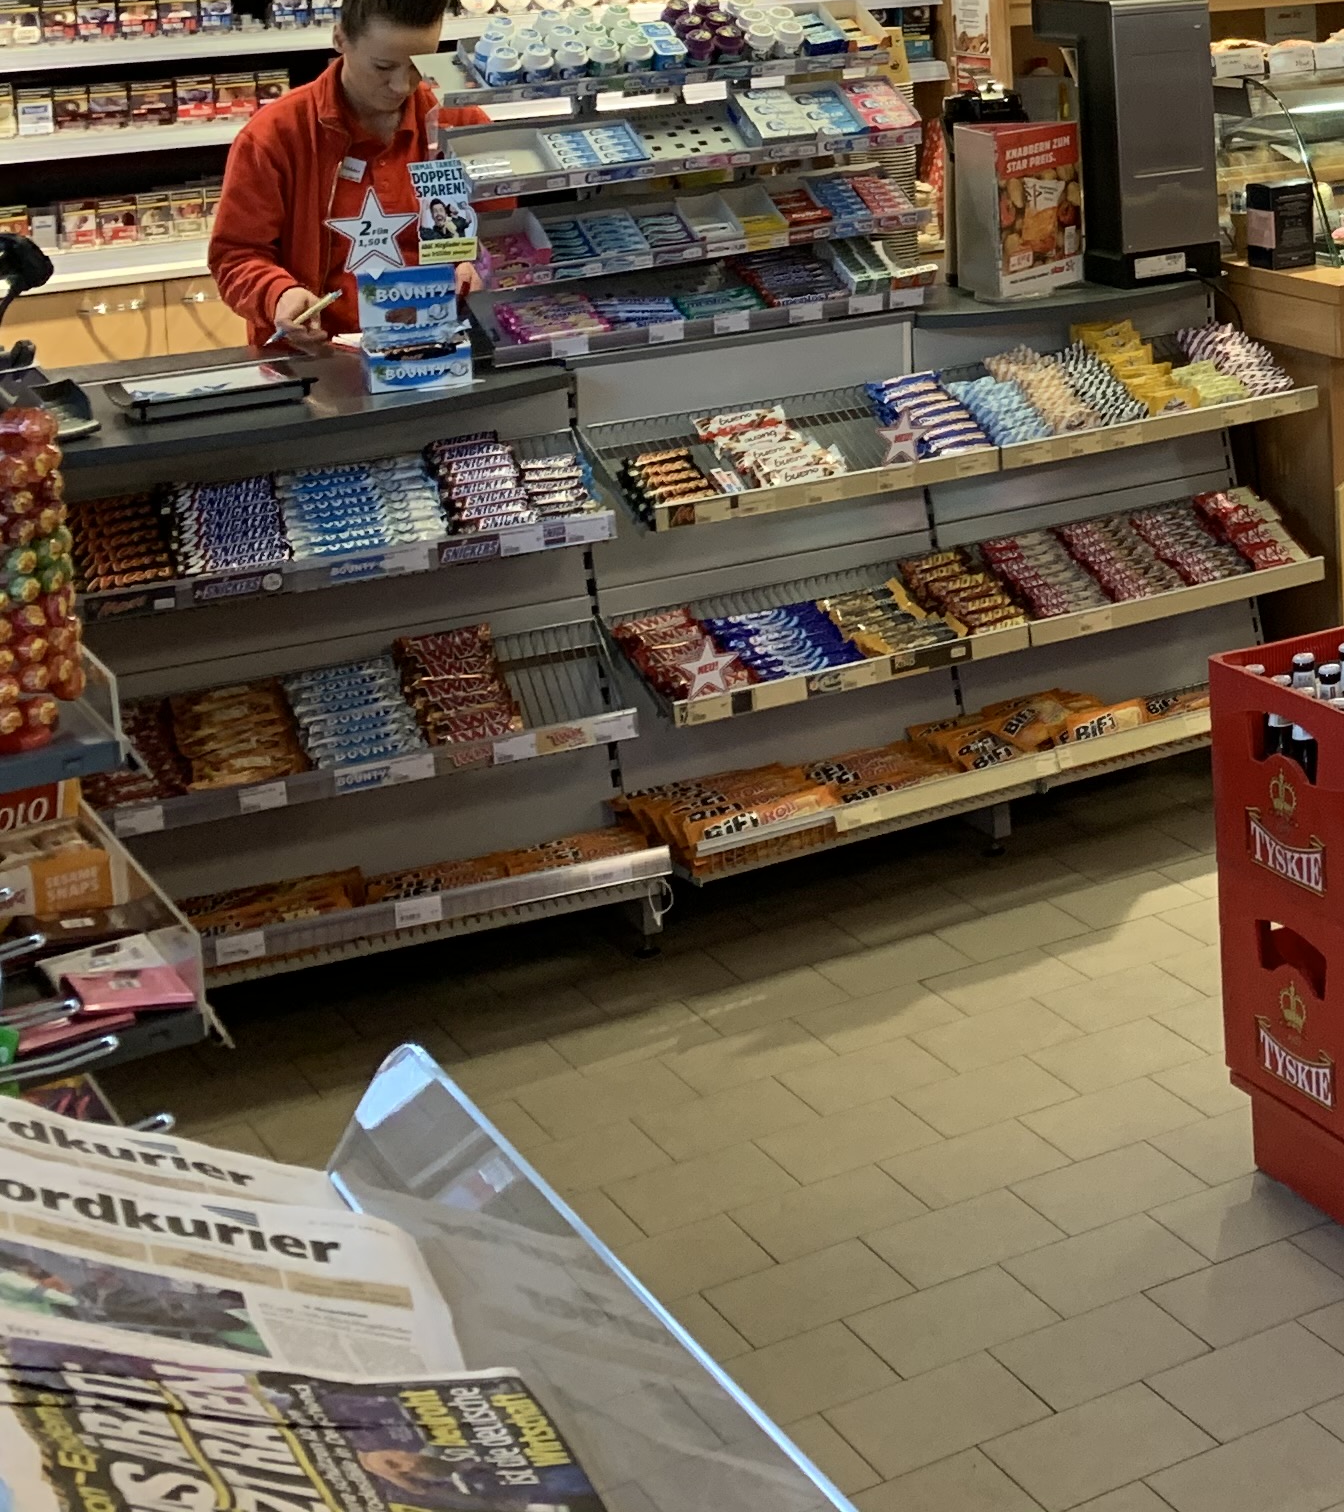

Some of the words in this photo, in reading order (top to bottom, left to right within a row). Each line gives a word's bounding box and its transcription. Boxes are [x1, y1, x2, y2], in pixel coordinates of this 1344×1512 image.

[1005, 140, 1051, 160] KNABBERN
[1052, 134, 1070, 149] ZUM
[412, 167, 463, 185] DOPPELT
[1006, 159, 1029, 174] STAR
[415, 182, 467, 198] SPAREN!
[359, 221, 372, 237] 2
[375, 283, 450, 303] BOUNTY
[385, 366, 445, 381] BOUNTY
[719, 412, 752, 425] bueno
[1250, 822, 1322, 891] TYSKIE
[1260, 1029, 1333, 1106] TYSKIE
[0, 1117, 255, 1187] dkurier
[449, 1386, 512, 1448] deutsche
